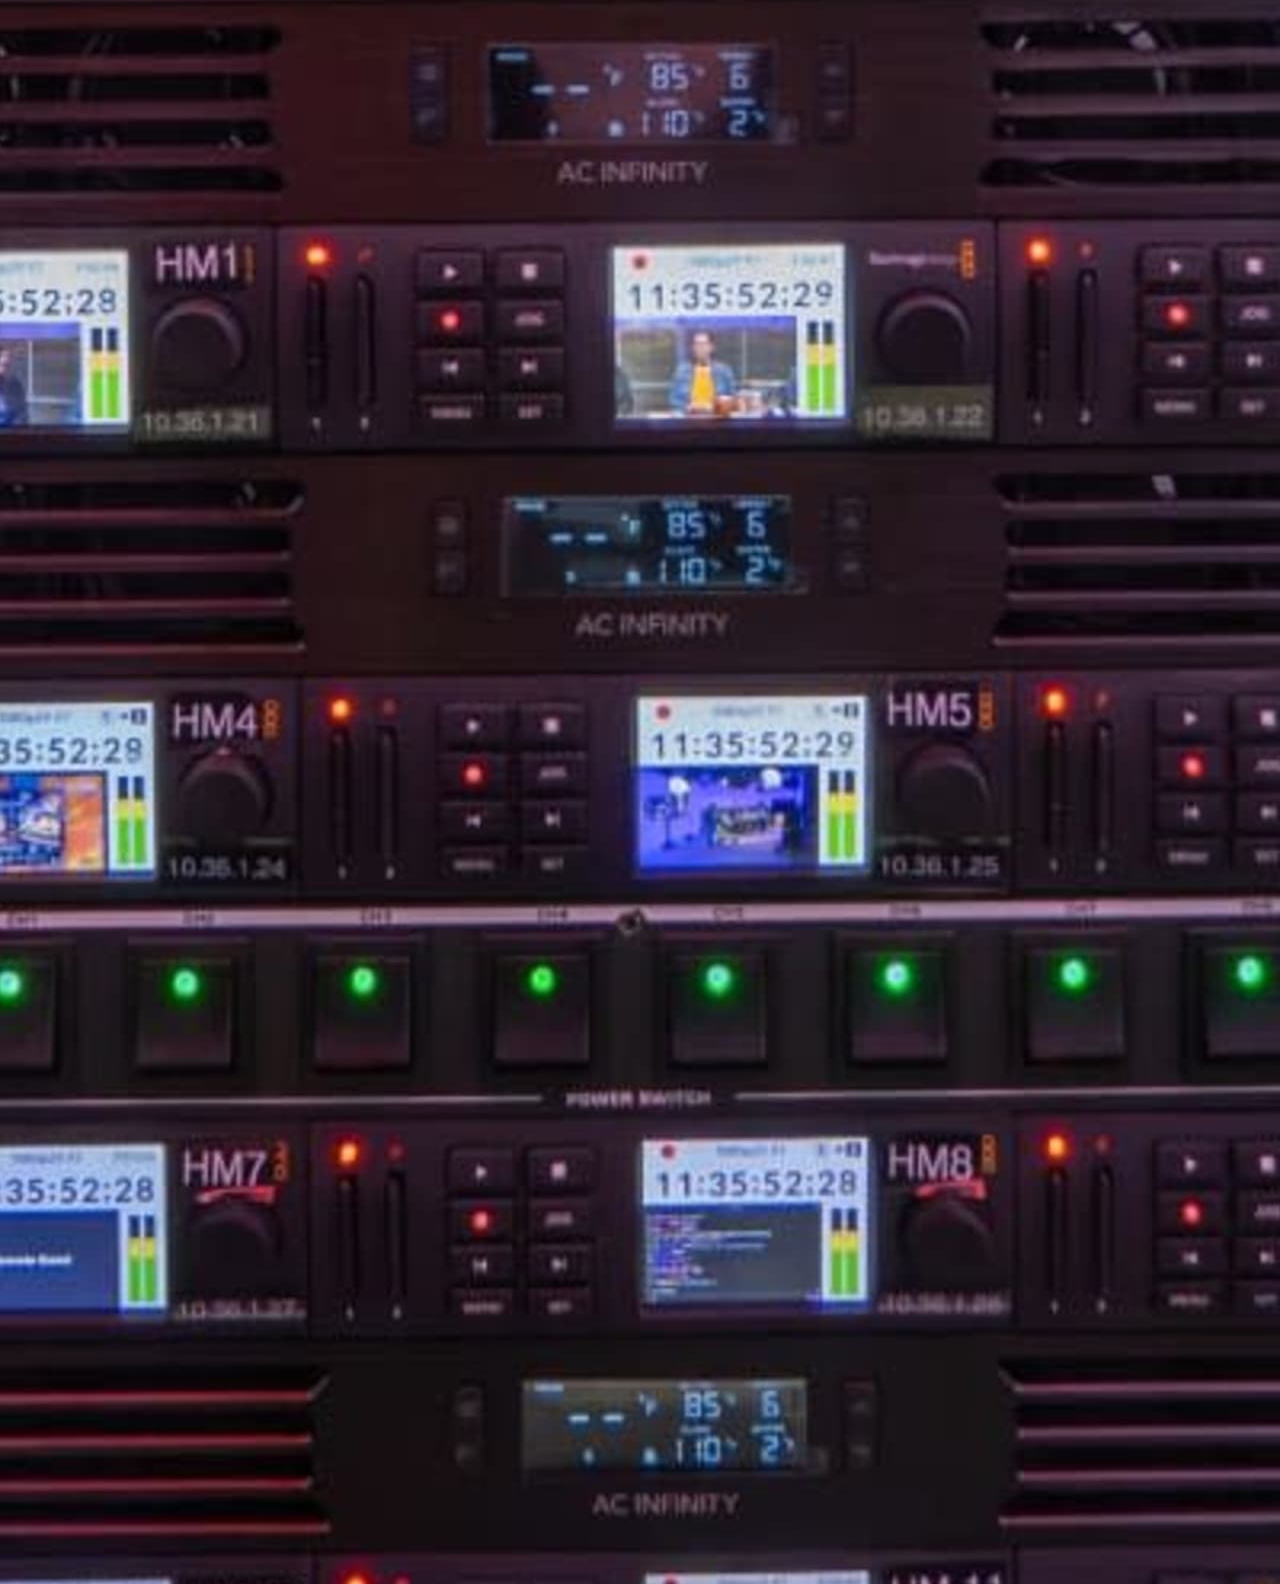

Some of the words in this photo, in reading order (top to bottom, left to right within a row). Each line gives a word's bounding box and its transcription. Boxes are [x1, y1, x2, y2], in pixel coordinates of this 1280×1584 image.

[650, 62, 689, 91] 85
[728, 62, 750, 90] 6
[557, 161, 595, 184] AC
[600, 161, 709, 184] INFINITY
[156, 246, 238, 283] HM1
[666, 511, 705, 539] 85
[746, 511, 765, 538] 6
[575, 613, 613, 637] AC
[619, 612, 730, 636] INFINITY
[173, 702, 259, 738] HM4
[887, 692, 973, 728] HM5
[565, 1090, 633, 1108] POWER
[183, 1150, 269, 1186] HM7
[889, 1143, 974, 1179] HM8
[683, 1391, 721, 1419] 85
[761, 1390, 780, 1418] 6
[592, 1493, 629, 1516] AC
[634, 1492, 741, 1515] INFINITY
